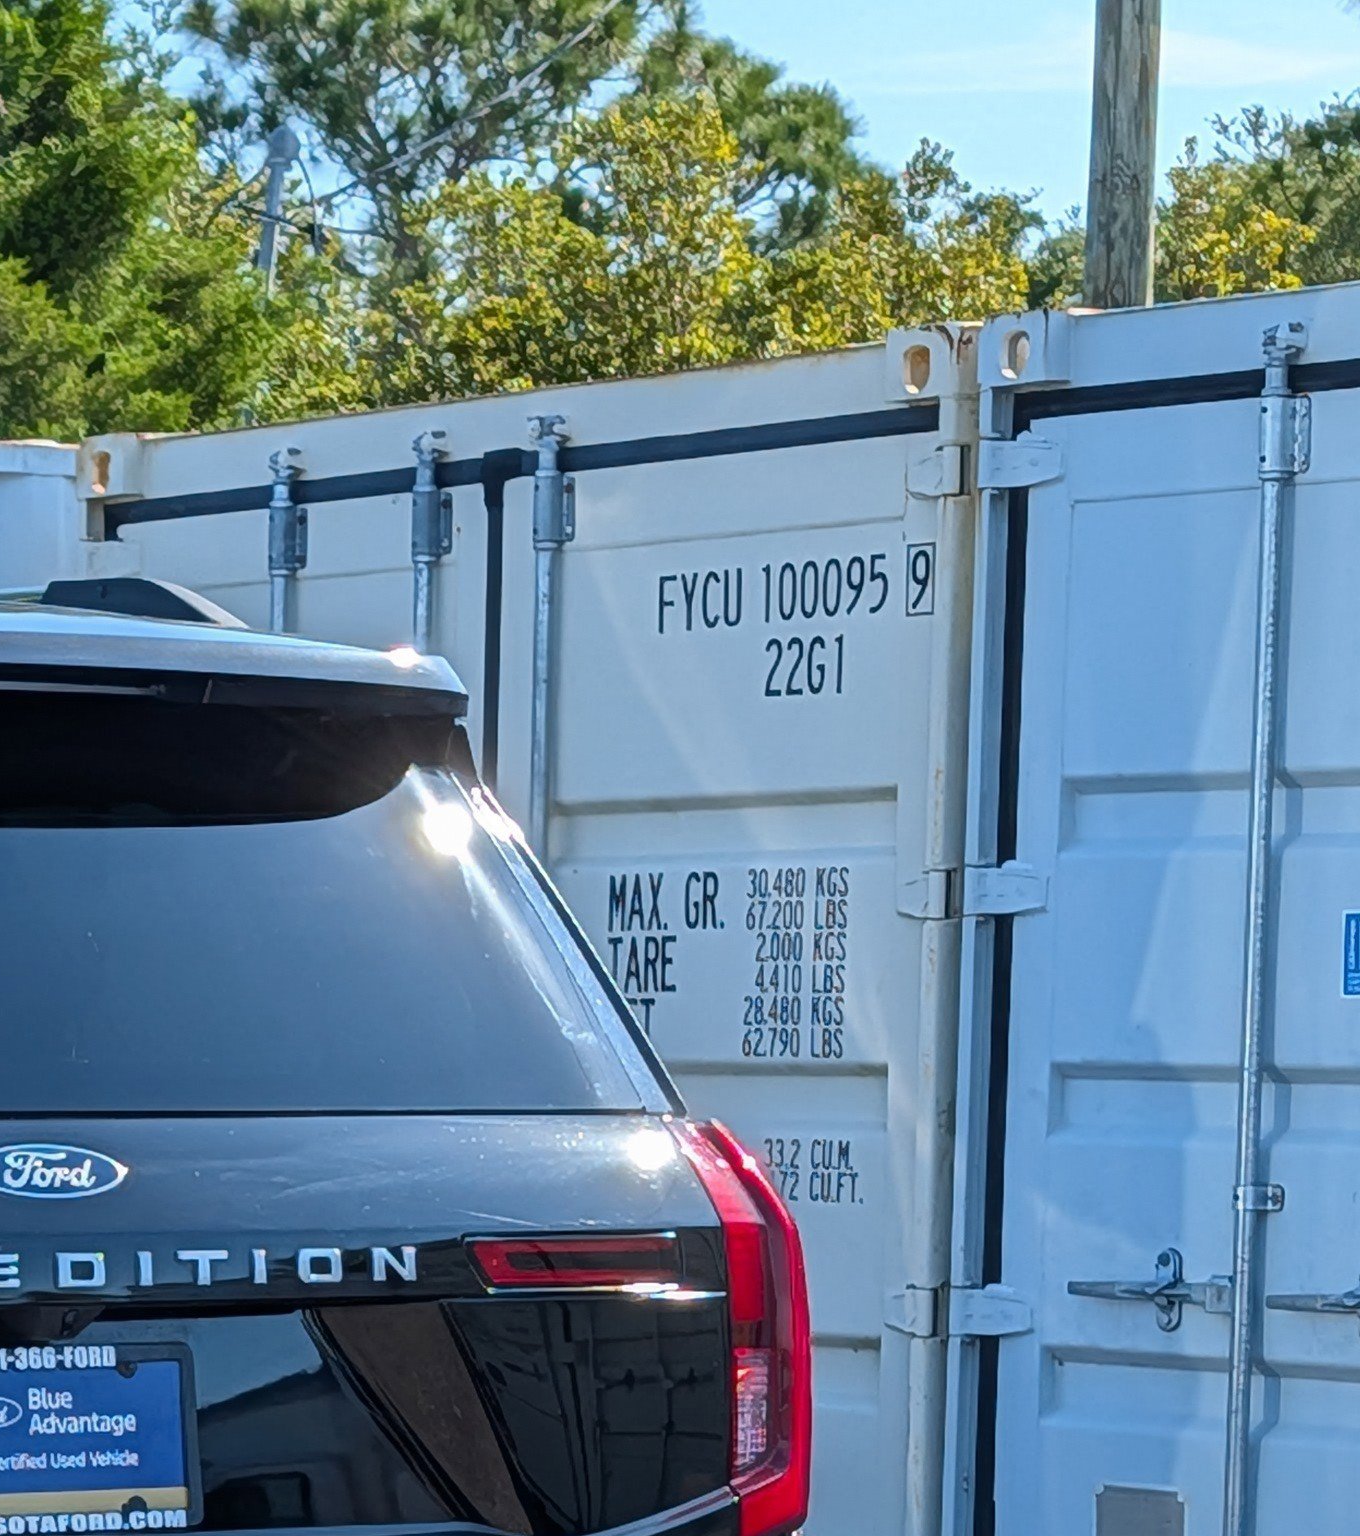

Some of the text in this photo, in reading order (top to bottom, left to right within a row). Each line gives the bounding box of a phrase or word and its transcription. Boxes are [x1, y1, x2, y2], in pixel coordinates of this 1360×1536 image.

[658, 549, 931, 634] FYCU 100095 9
[764, 633, 845, 697] 22G1
[746, 866, 850, 899] 30.480 KGS
[607, 871, 726, 932] MAX. GR.
[813, 899, 848, 930] LBS
[811, 931, 848, 962] KGS
[607, 935, 678, 993] TARE
[811, 964, 846, 994] LBS
[810, 995, 845, 1026] KGS
[810, 1028, 844, 1059] LBS
[3, 1151, 97, 1188] Ford
[28, 1388, 73, 1410] Blue
[29, 1411, 137, 1437] Advantage
[51, 1450, 86, 1469] Used
[90, 1450, 139, 1467] Vehicle
